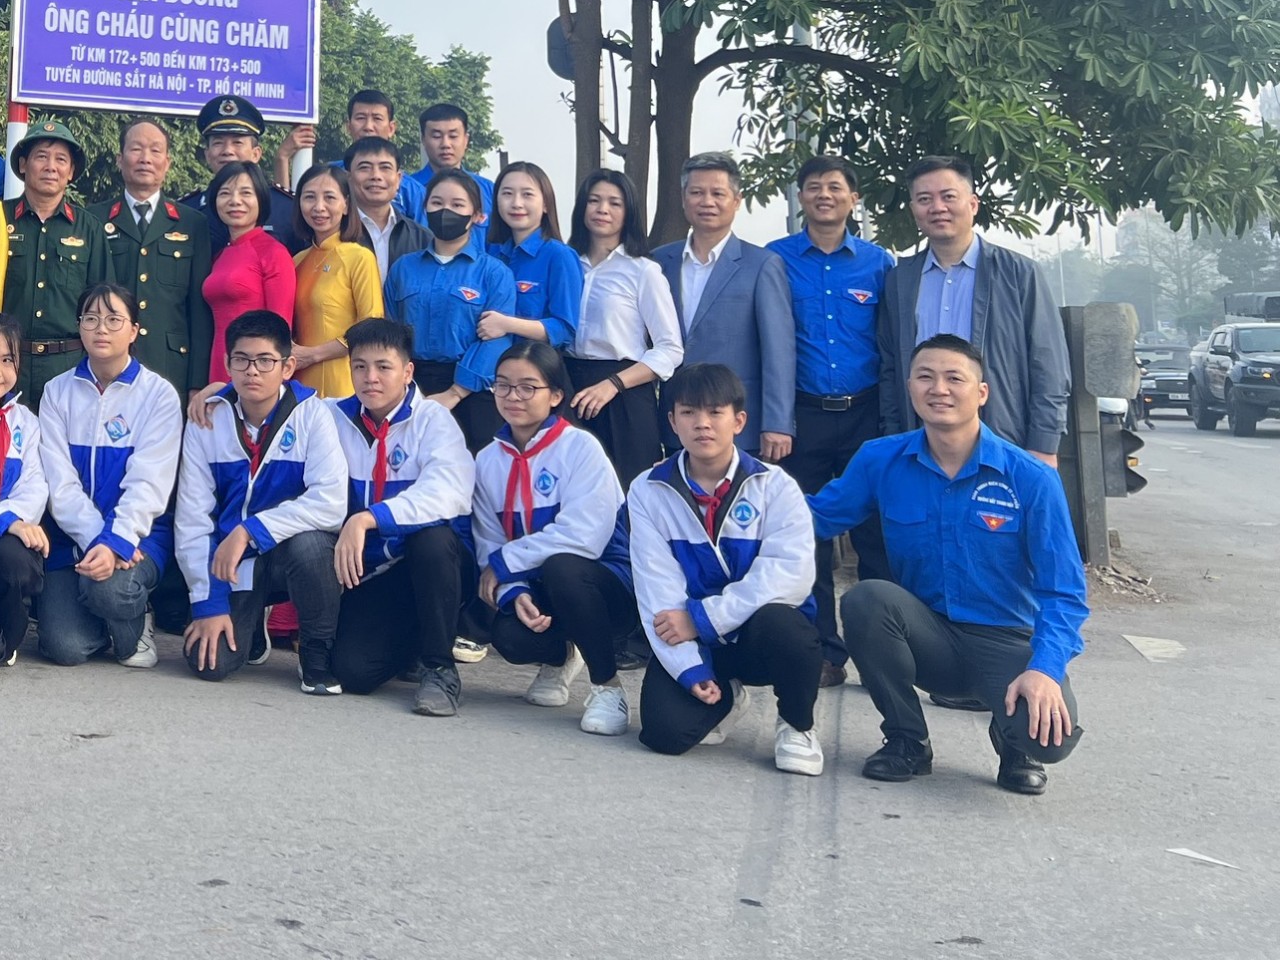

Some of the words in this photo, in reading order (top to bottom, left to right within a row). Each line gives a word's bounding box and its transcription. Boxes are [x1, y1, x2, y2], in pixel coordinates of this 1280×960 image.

[44, 2, 90, 34] ÔNG
[96, 8, 154, 39] CHÁU
[160, 12, 219, 44] CÙNG
[226, 18, 289, 50] CHĂM
[71, 43, 86, 61] TỪ
[87, 47, 106, 63] KM
[163, 49, 186, 69] ĐẾN
[188, 55, 207, 70] KM
[45, 64, 80, 84] TUYẾN
[83, 67, 122, 87] ĐƯỜNG
[125, 68, 146, 88] SẮT
[148, 72, 164, 90] HÀ
[167, 73, 186, 94] NỘI
[197, 78, 212, 94] TP.
[233, 79, 252, 97] CHÍ
[254, 82, 285, 99] MINH
